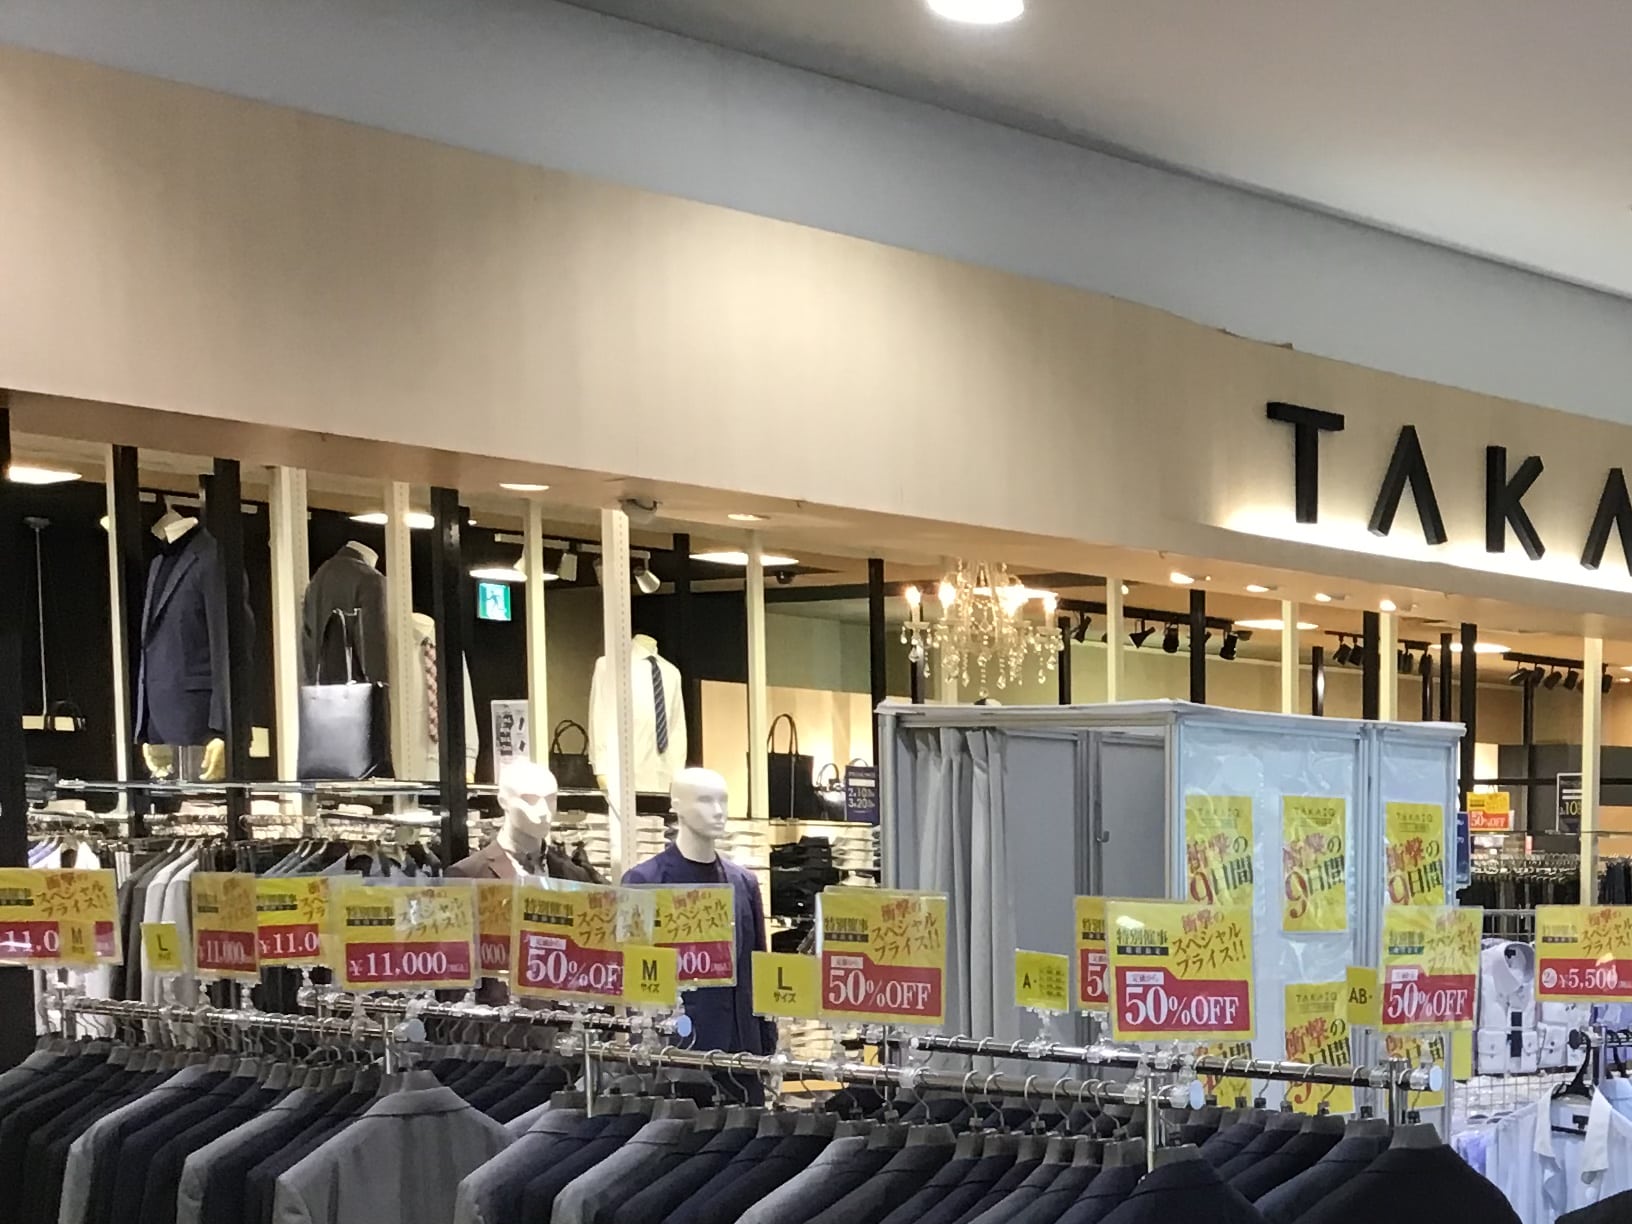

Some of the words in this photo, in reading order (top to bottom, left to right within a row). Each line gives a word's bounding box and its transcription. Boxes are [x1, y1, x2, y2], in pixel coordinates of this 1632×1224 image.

[1284, 854, 1345, 919] 9日間
[350, 951, 447, 977] ¥11,000
[526, 948, 624, 991] 50%OF
[642, 959, 658, 981] M
[640, 983, 660, 993] サイズ
[777, 966, 793, 991] L
[828, 969, 931, 1010] 50%OFF
[1559, 967, 1619, 990] ¥5,500
[773, 991, 797, 1004] サイズ
[1125, 986, 1239, 1026] 50%OFF
[1387, 982, 1468, 1019] 50%OFF
